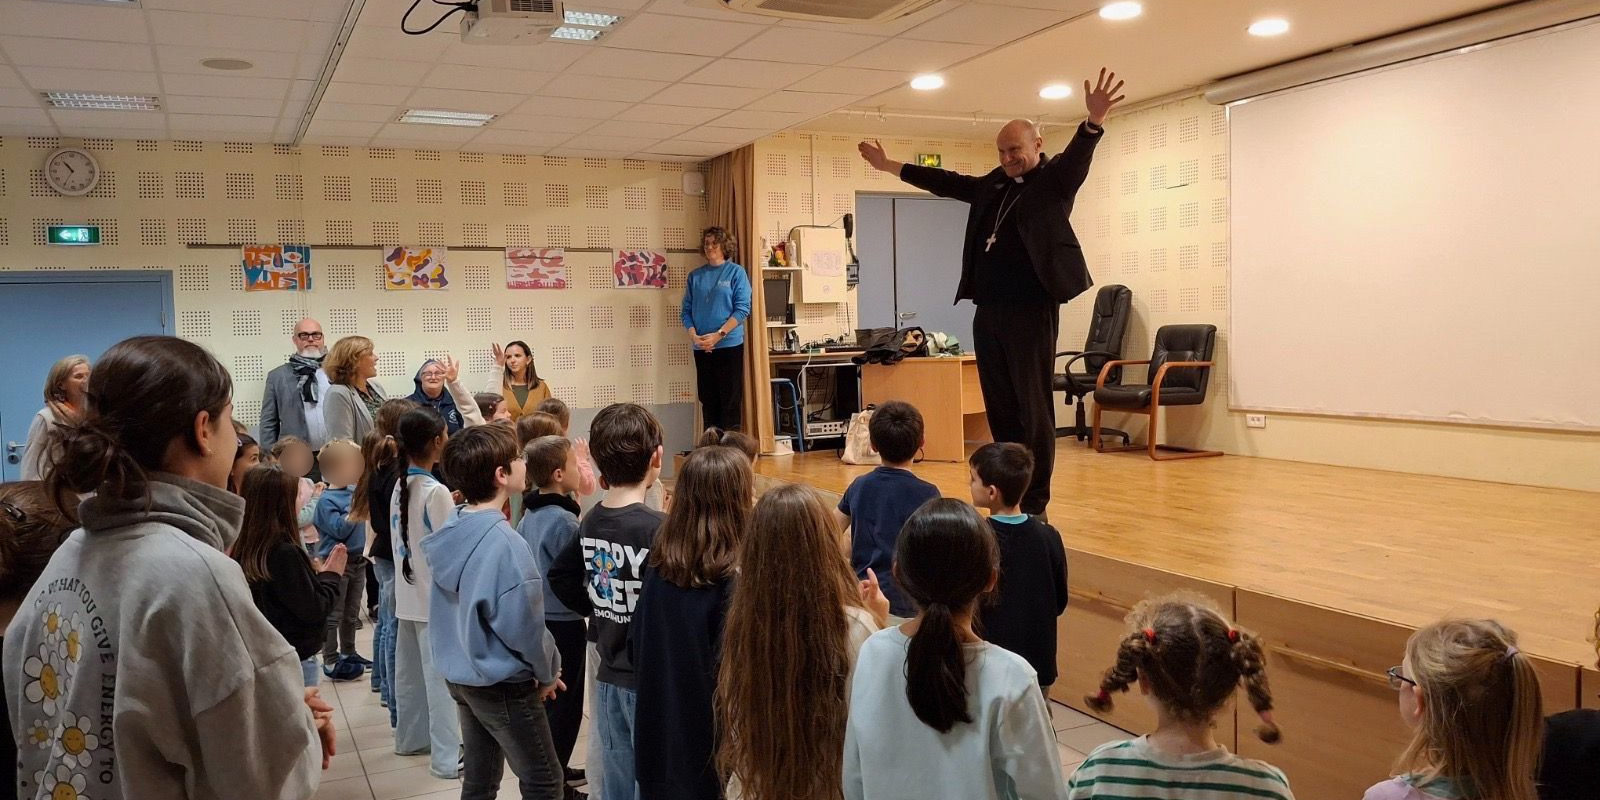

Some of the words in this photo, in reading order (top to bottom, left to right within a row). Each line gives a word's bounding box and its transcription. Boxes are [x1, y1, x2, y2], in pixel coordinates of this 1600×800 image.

[79, 583, 97, 614] YOU
[90, 616, 115, 664] GIVE
[100, 673, 115, 752] ENERGY
[99, 757, 114, 784] TO
